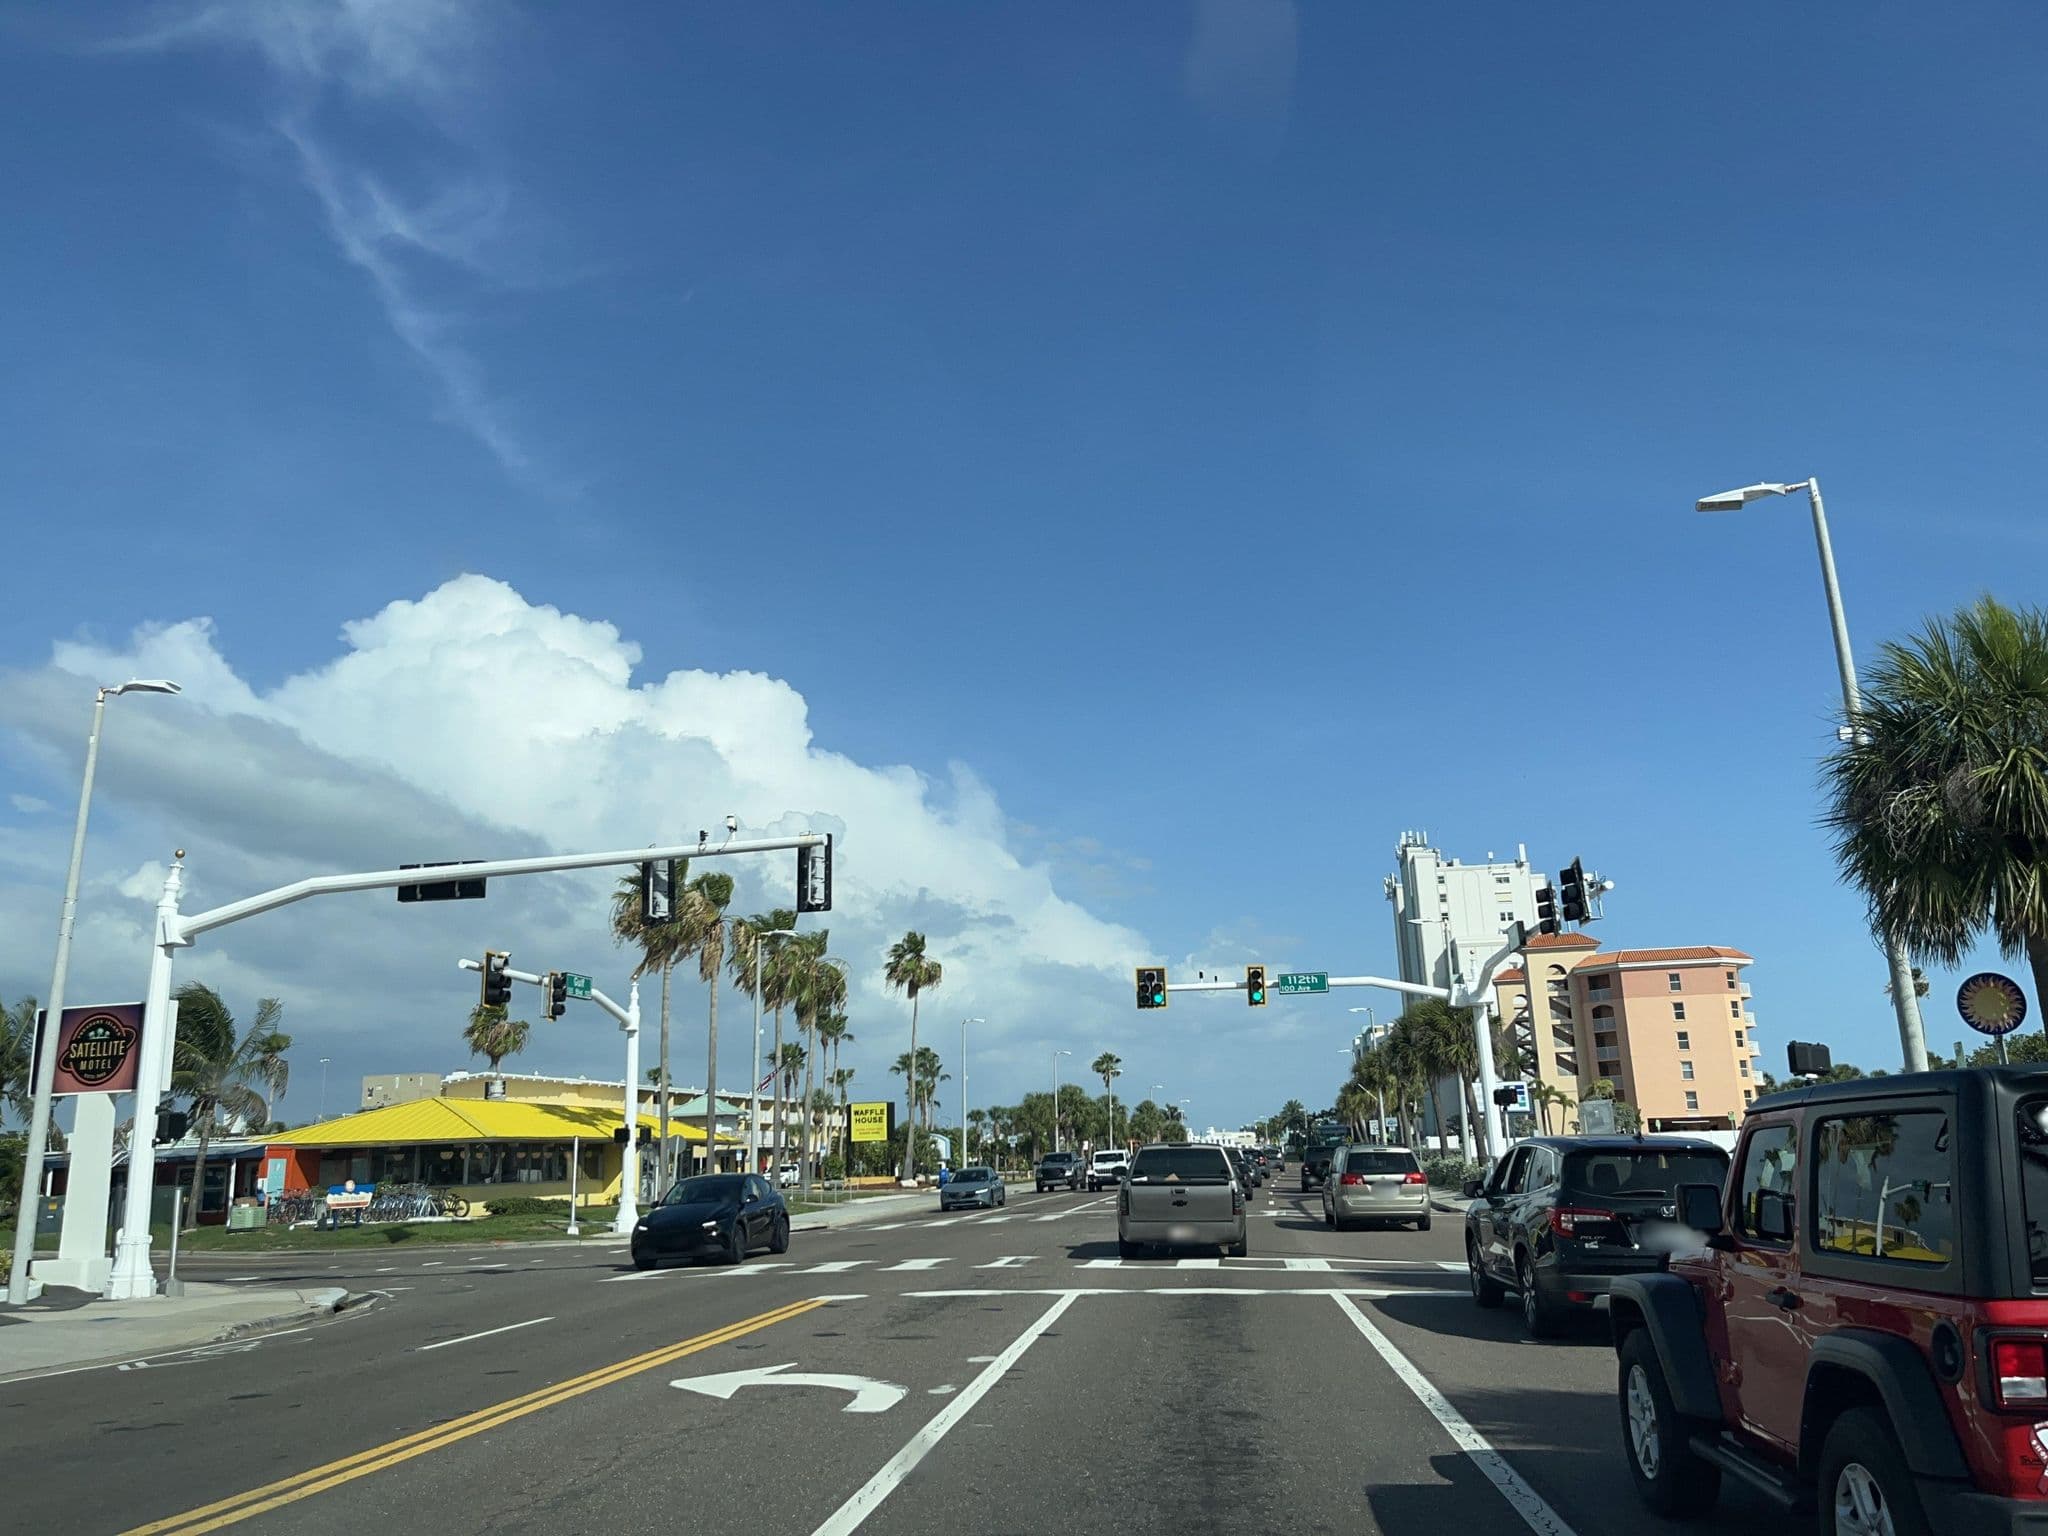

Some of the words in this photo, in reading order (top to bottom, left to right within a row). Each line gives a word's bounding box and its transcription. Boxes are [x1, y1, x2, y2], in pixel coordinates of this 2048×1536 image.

[1288, 975, 1318, 985] 112th
[70, 1040, 126, 1058] SATELLITE
[79, 1059, 112, 1071] MOTEL
[853, 1108, 885, 1116] WAFFLE
[855, 1116, 884, 1124] HOUSE
